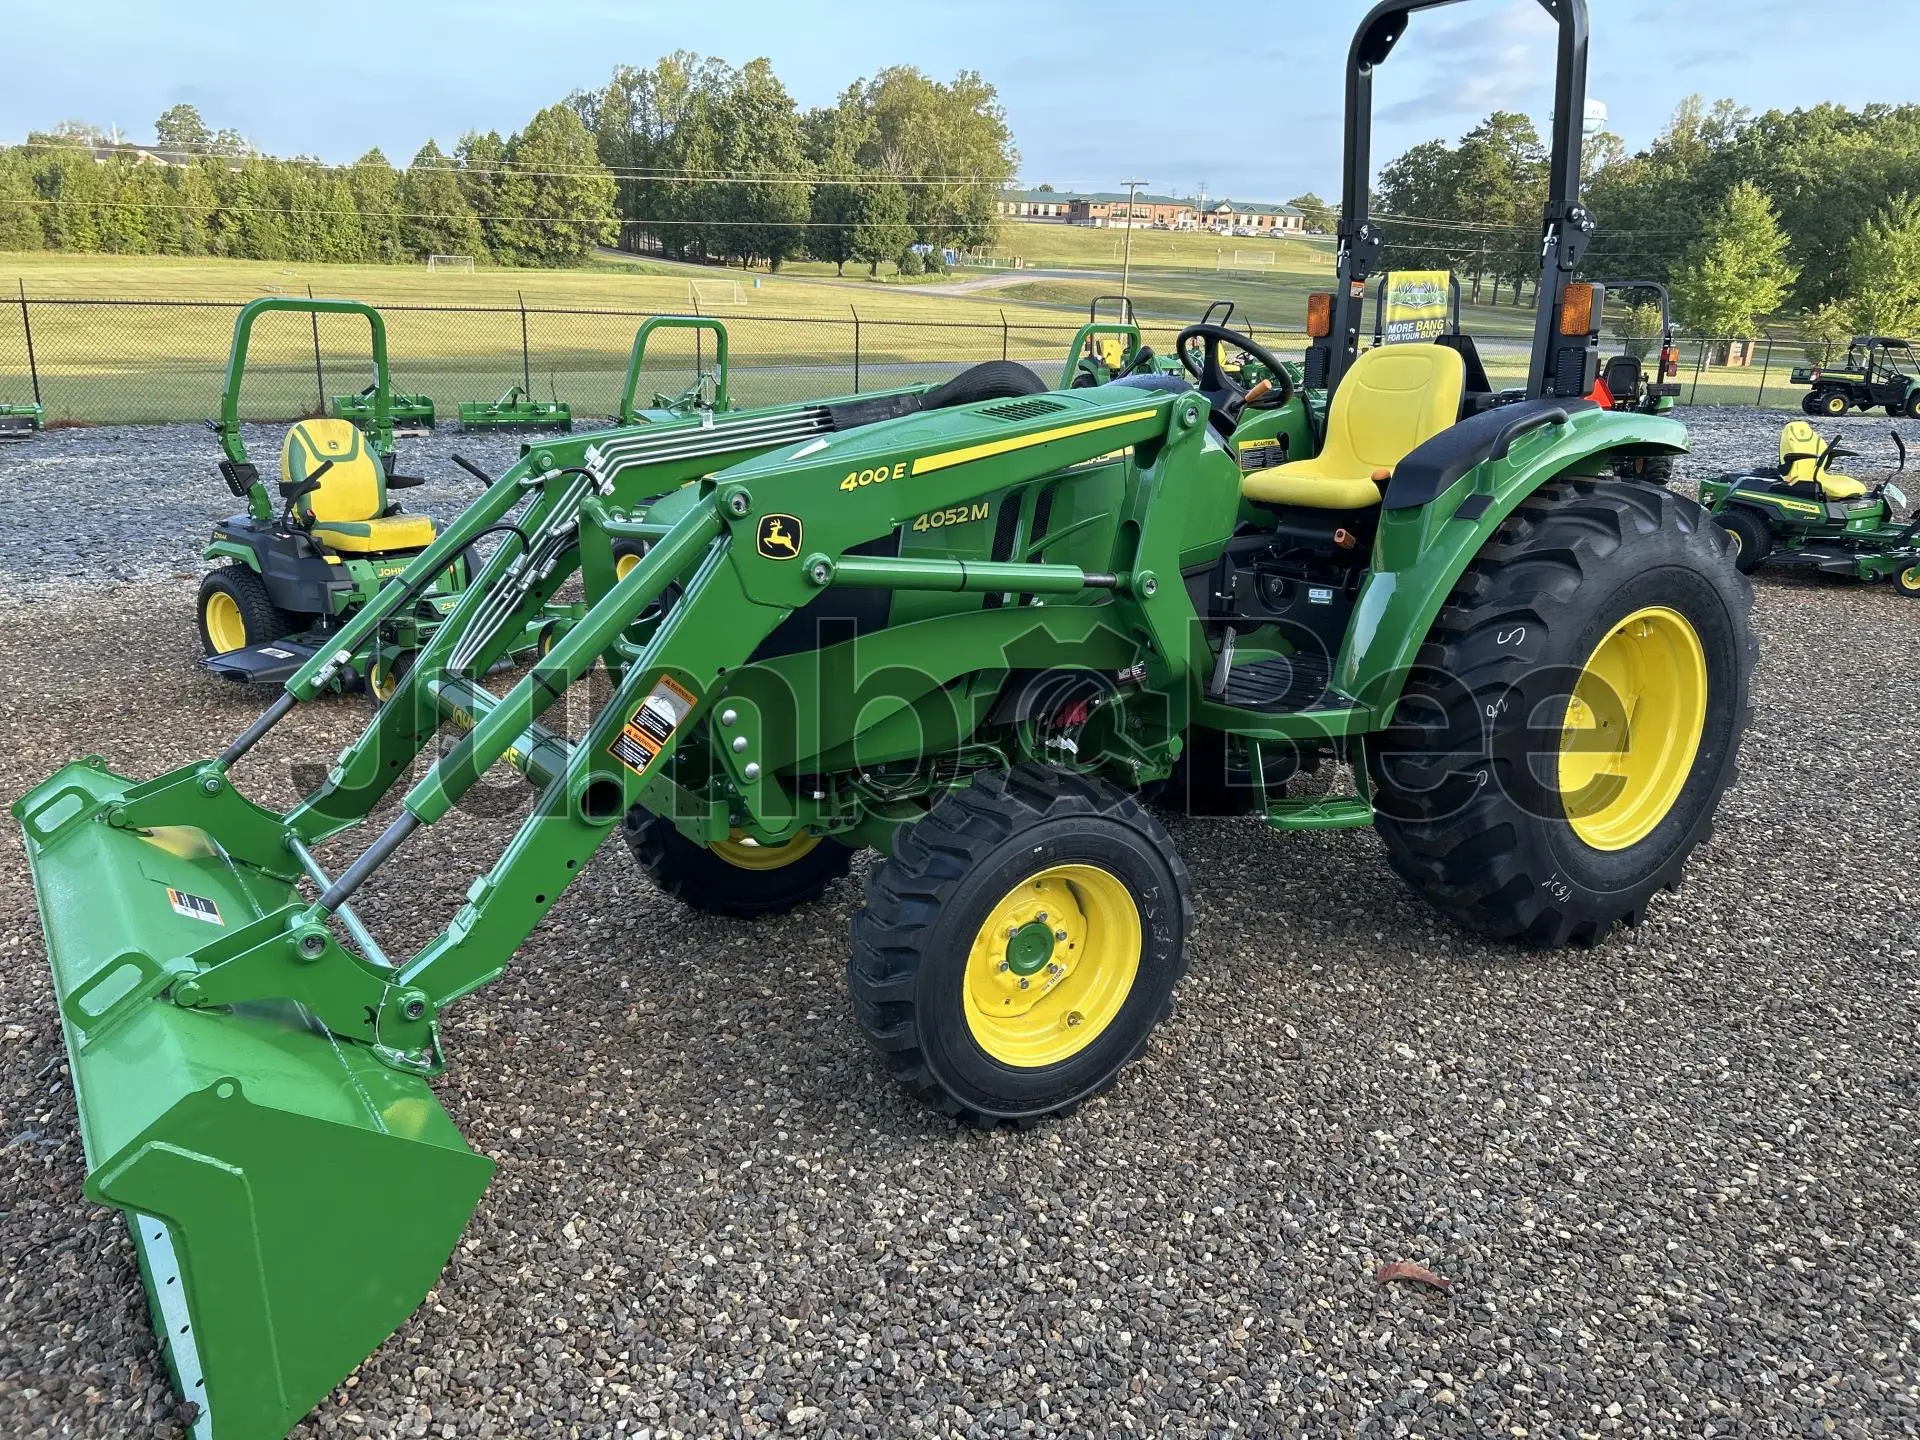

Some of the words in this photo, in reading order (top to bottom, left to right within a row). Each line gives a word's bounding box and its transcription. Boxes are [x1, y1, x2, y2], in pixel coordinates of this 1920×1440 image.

[1388, 322, 1415, 334] MORE
[1416, 319, 1444, 331] BANG
[1387, 333, 1401, 342] FOR
[1401, 331, 1420, 341] YOUR
[670, 681, 693, 702] WARNING
[633, 733, 657, 752] WARNING
